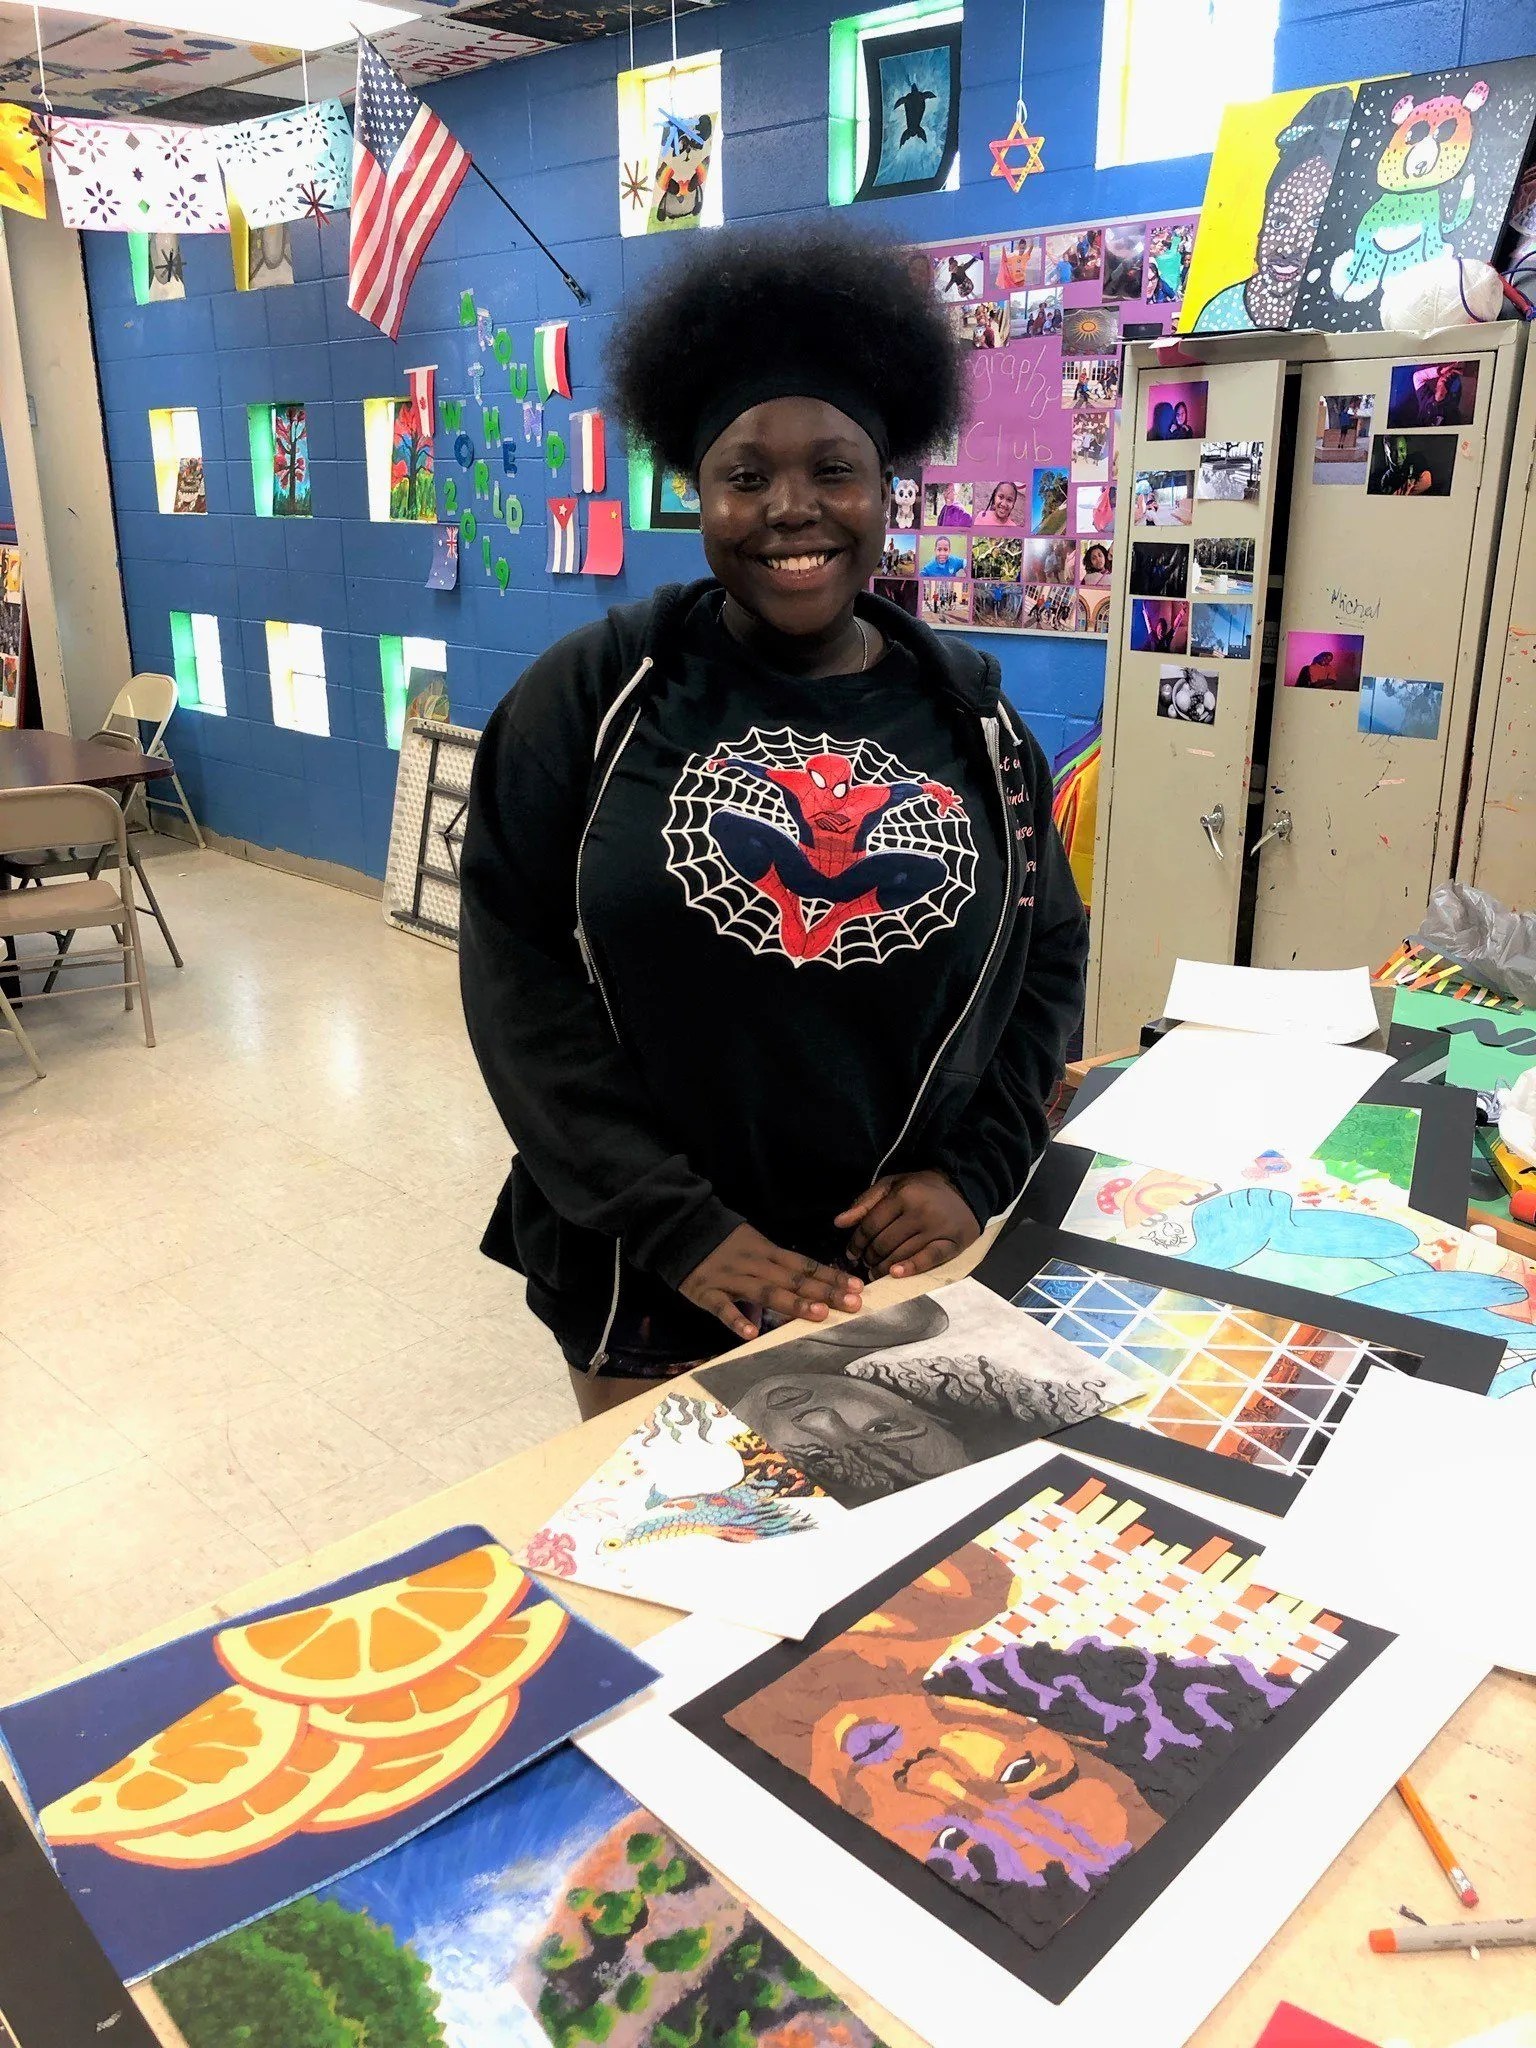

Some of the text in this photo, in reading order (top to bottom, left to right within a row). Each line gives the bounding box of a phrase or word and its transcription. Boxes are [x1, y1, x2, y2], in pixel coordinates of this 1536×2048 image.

[458, 292, 566, 471] AROUND
[468, 362, 518, 475] THE
[439, 401, 523, 532] WORLD
[965, 421, 1053, 467] Club
[444, 479, 510, 592] 2019
